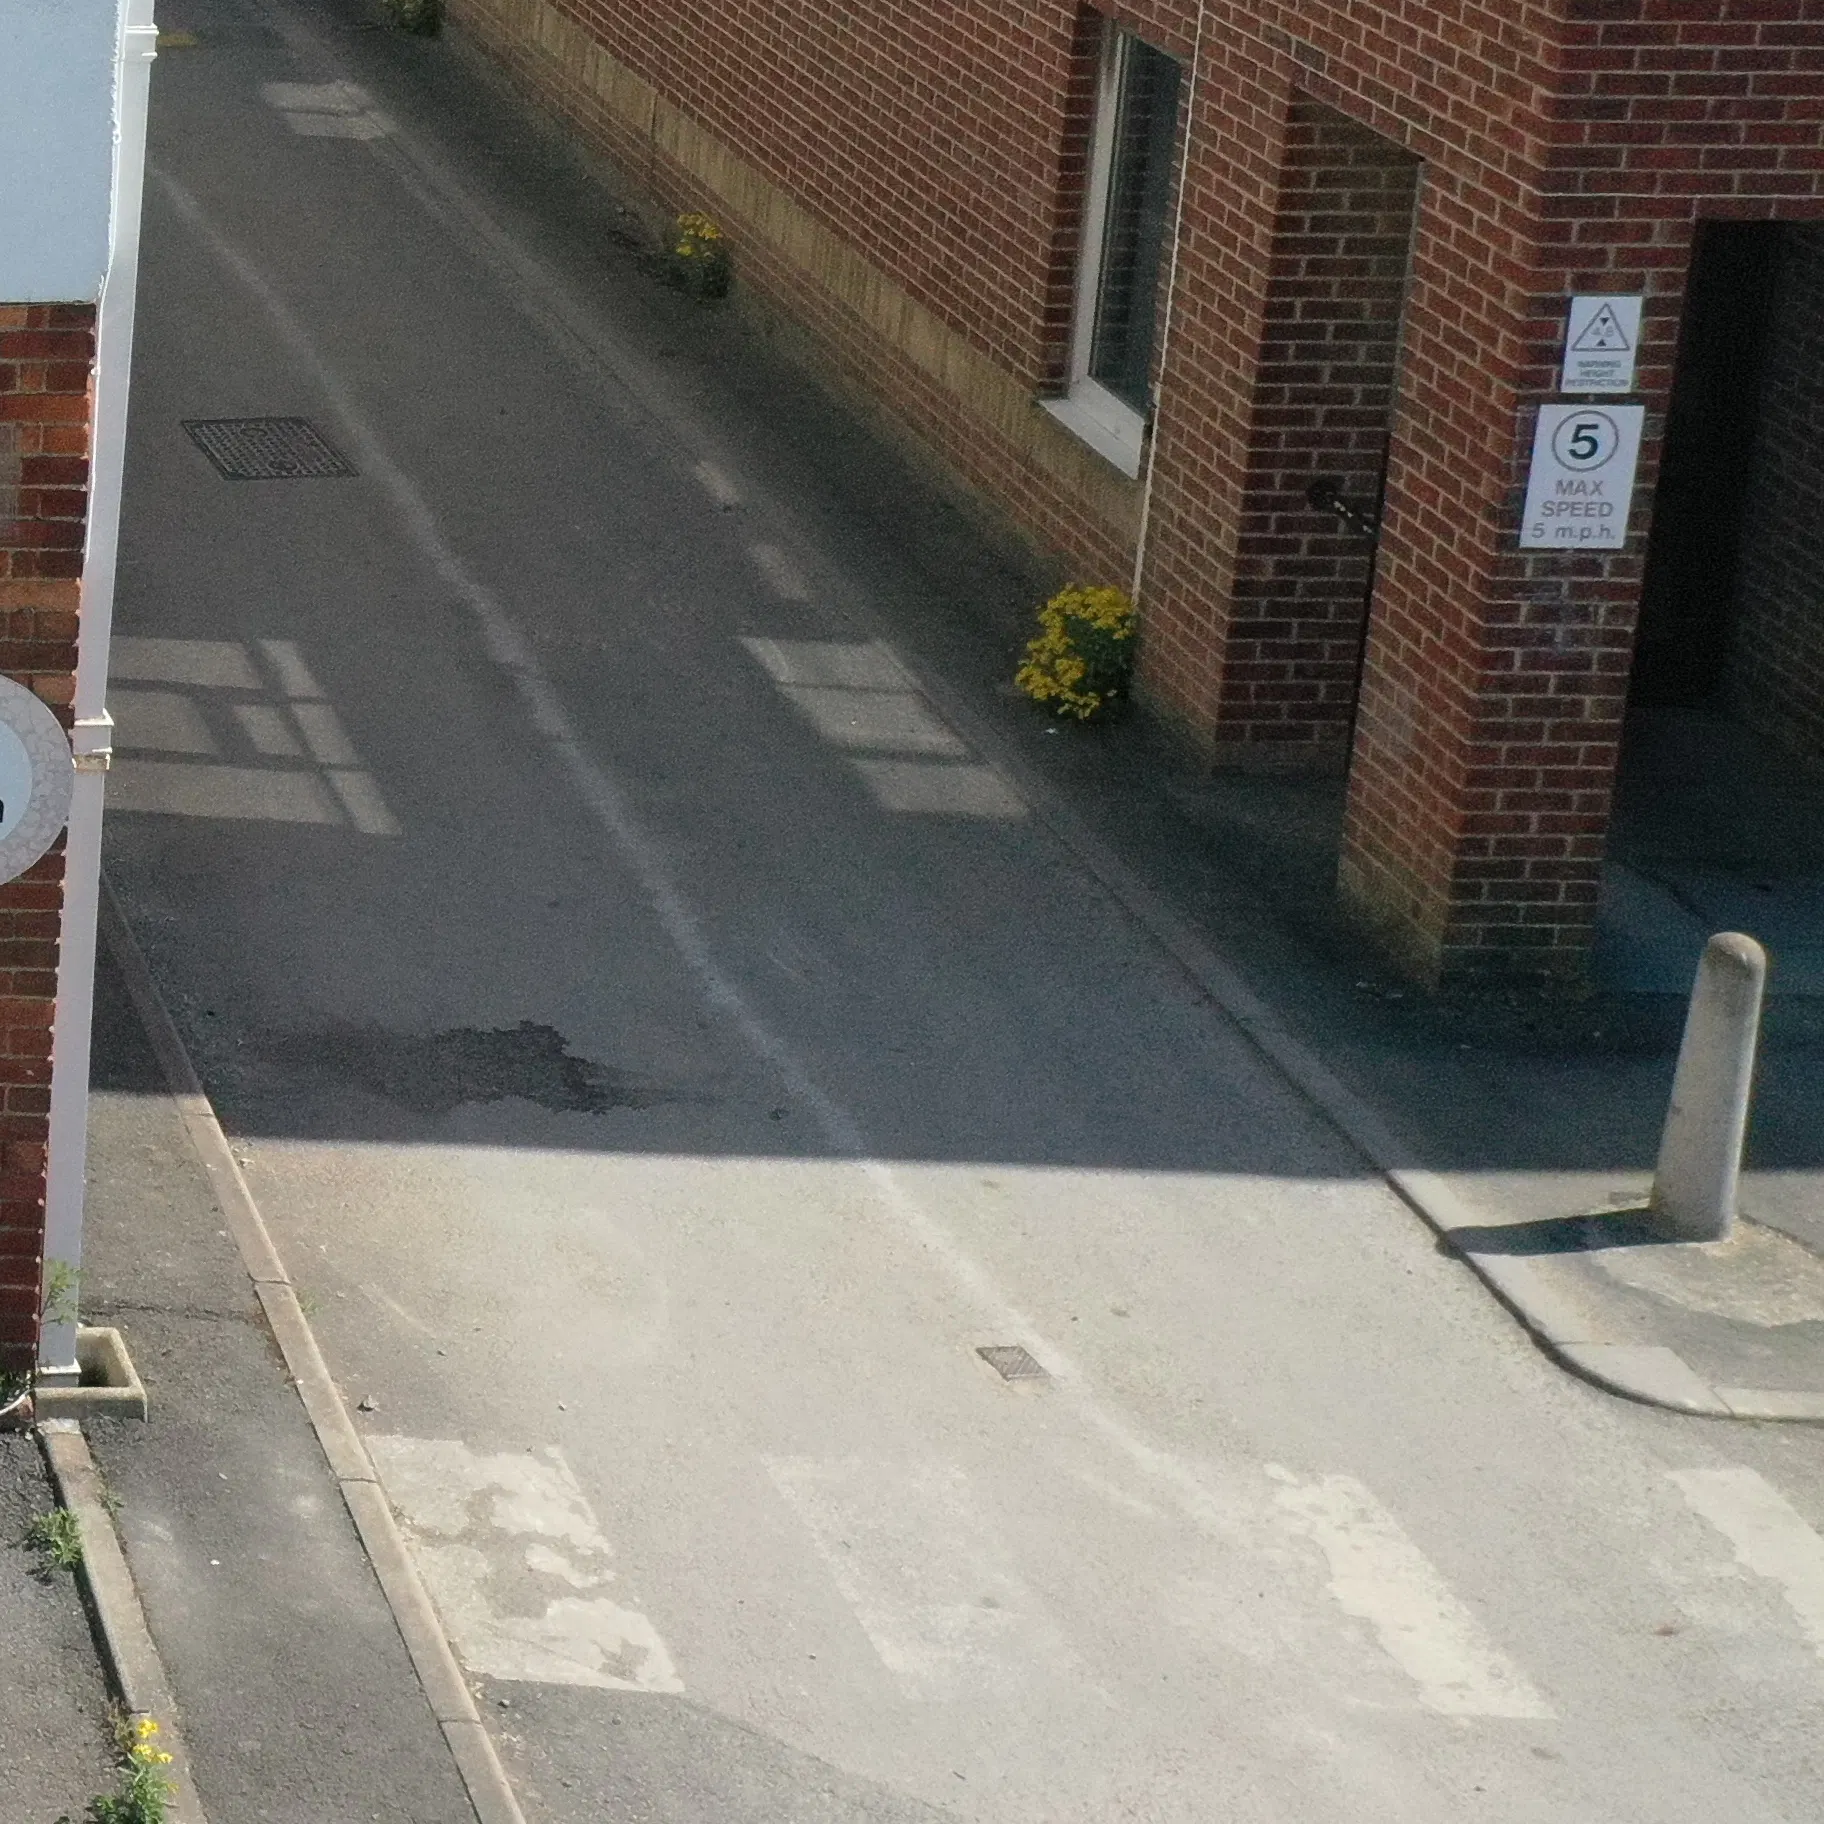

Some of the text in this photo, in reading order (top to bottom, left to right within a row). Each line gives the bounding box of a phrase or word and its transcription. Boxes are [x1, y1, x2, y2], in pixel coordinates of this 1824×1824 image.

[1568, 423, 1599, 460] 5
[1555, 479, 1604, 496] MAX
[1541, 500, 1614, 517] SPEED
[1532, 522, 1546, 538] 5
